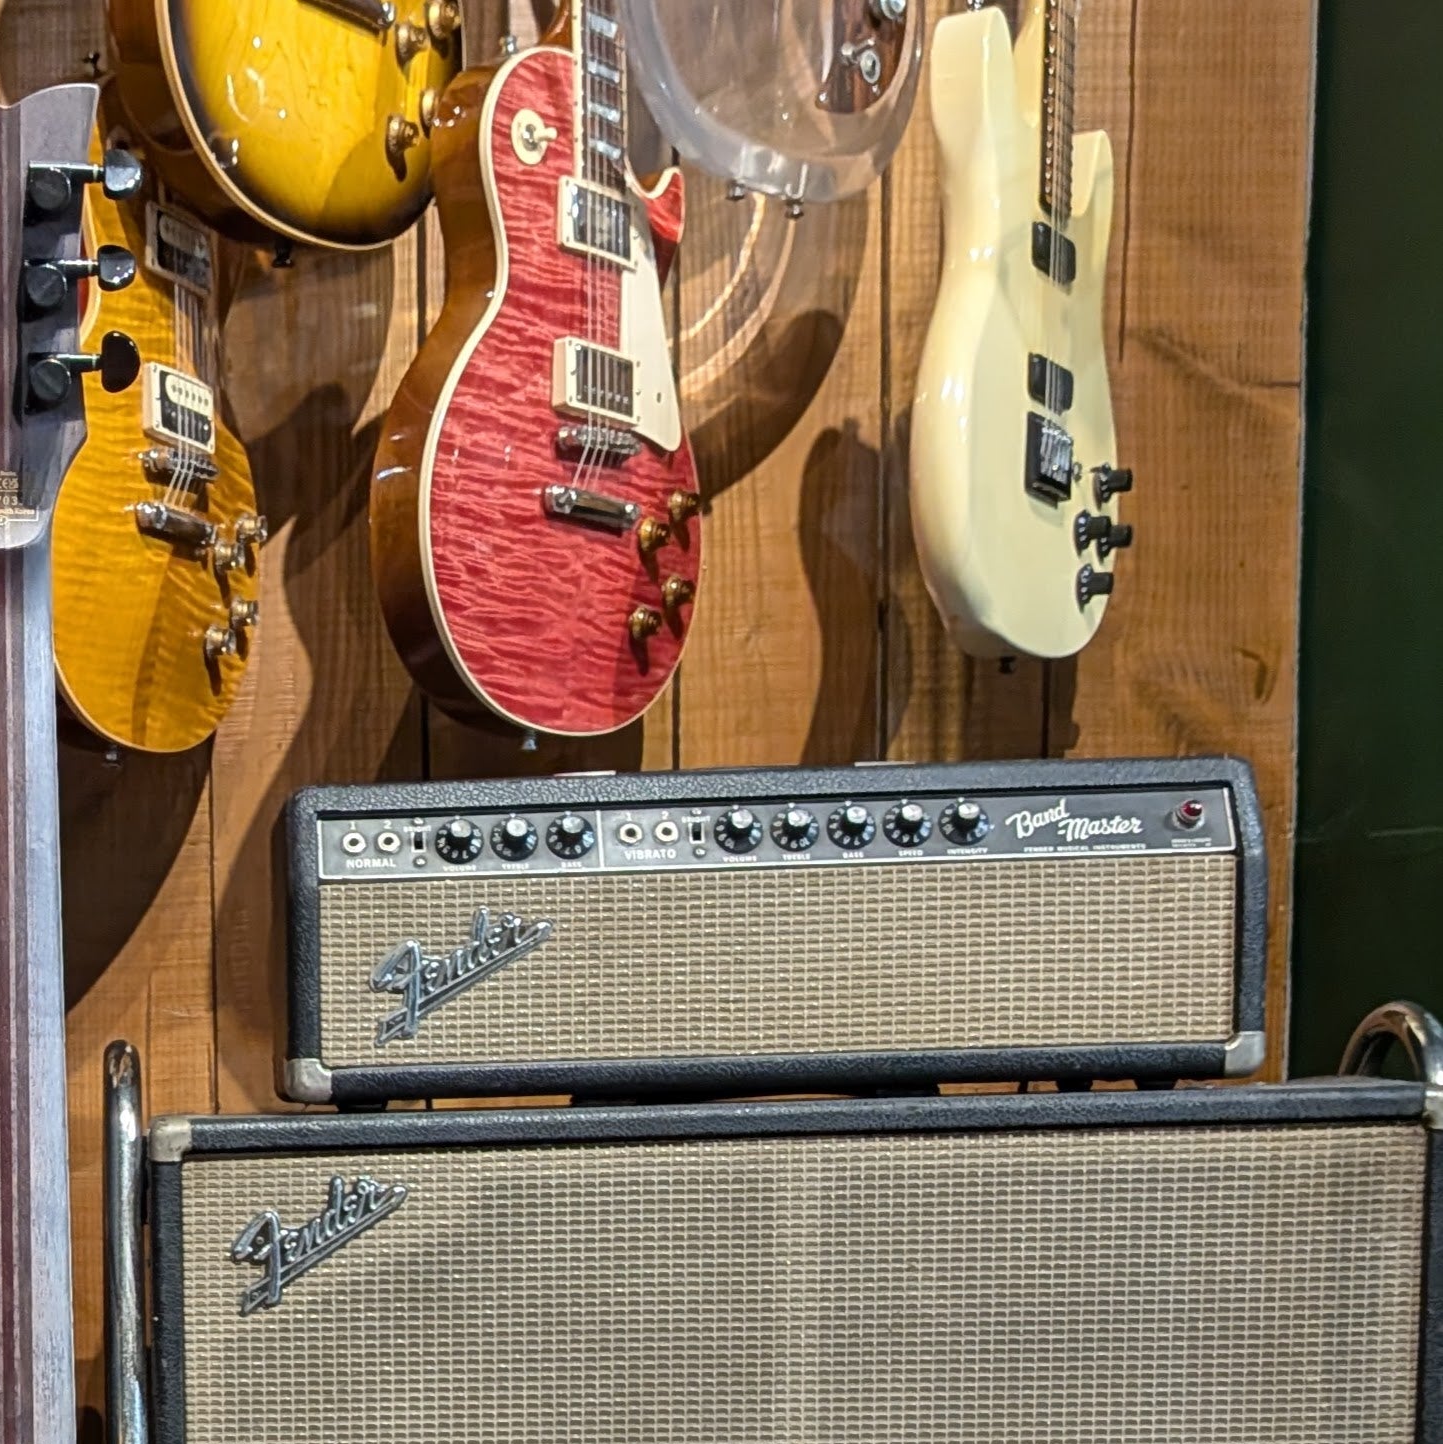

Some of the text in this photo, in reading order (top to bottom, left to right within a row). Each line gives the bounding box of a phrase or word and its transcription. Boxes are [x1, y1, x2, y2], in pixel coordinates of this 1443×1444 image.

[662, 811, 669, 820] 2
[1005, 797, 1070, 839] Band
[1057, 815, 1144, 842] Master
[349, 821, 356, 830] 1
[383, 820, 392, 829] 2
[624, 848, 677, 860] VIBRATO
[842, 851, 864, 859] BASS
[898, 849, 924, 857] SPEED
[947, 847, 988, 855] INTENSITY
[782, 853, 811, 861] TREBLE
[346, 858, 397, 869] NORMAL
[442, 864, 477, 872] VOLUME
[560, 861, 583, 869] BASS
[370, 905, 554, 1046] Fender
[233, 1175, 407, 1316] Fender
